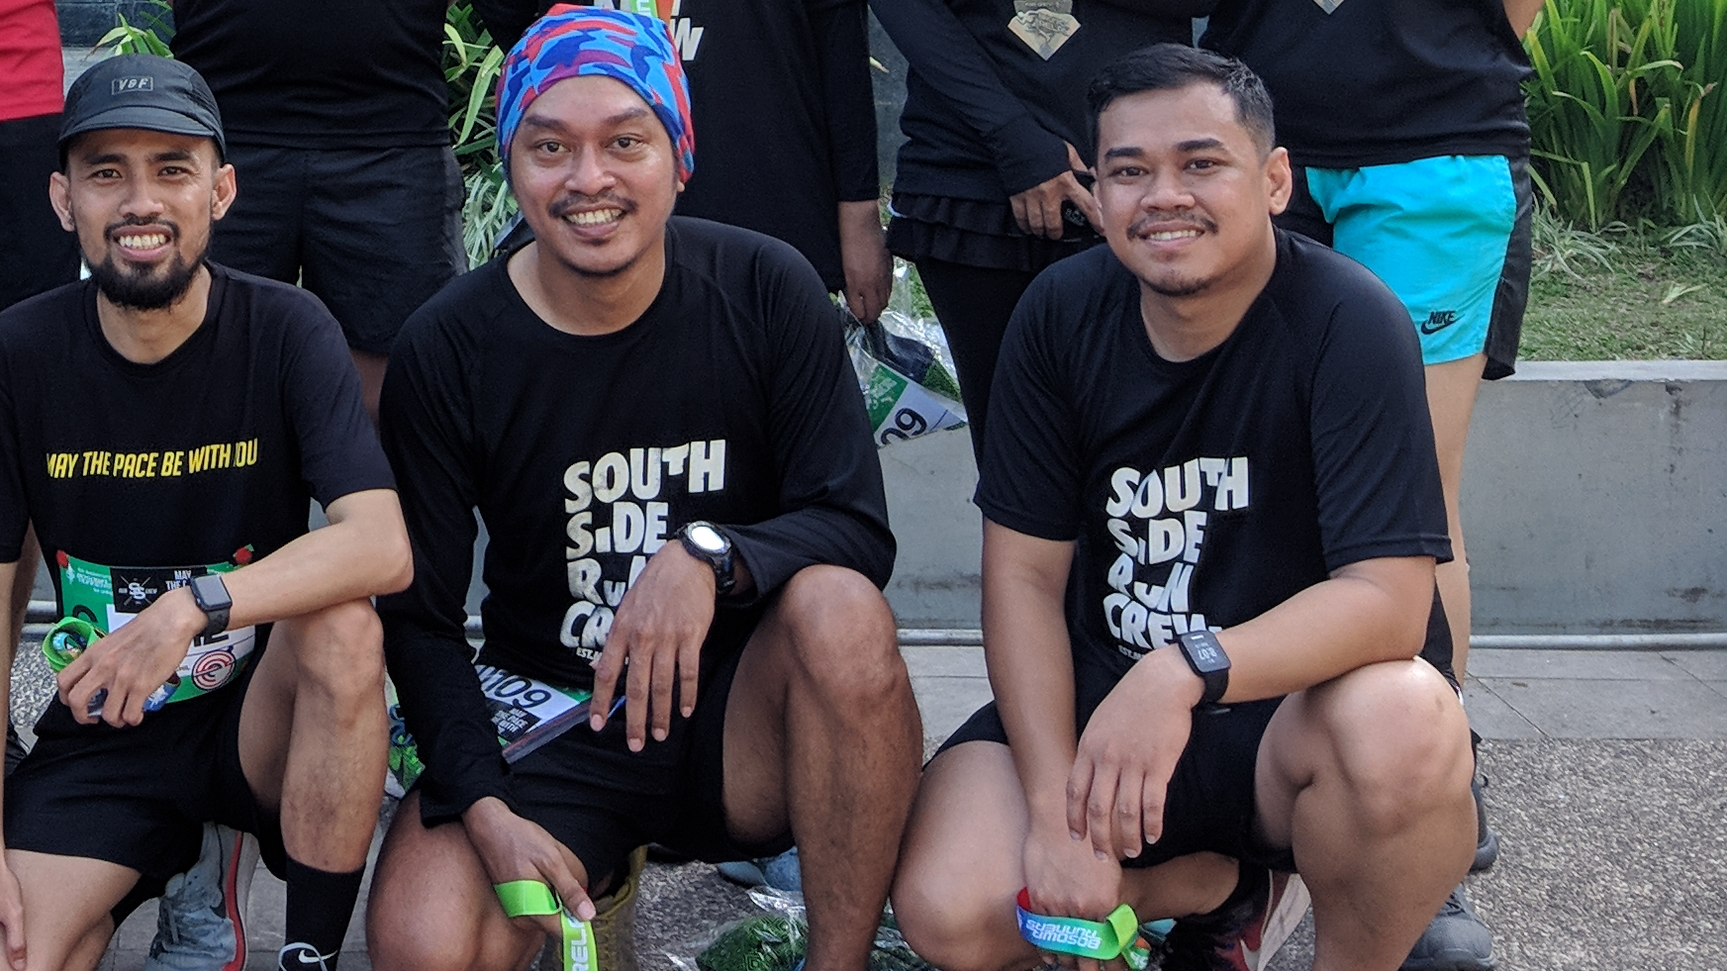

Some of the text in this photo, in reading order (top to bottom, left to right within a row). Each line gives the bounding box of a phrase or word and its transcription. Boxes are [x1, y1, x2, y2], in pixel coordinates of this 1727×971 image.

[1427, 310, 1457, 325] NIKE
[82, 450, 112, 477] THE
[112, 451, 160, 479] PACE
[160, 450, 185, 477] BE
[188, 442, 232, 474] WITH
[562, 438, 727, 514] SOUTH
[1105, 456, 1250, 519] SOUTH
[565, 501, 670, 560] SIDE
[1106, 509, 1208, 566] SIDE
[1107, 552, 1195, 613] RUN
